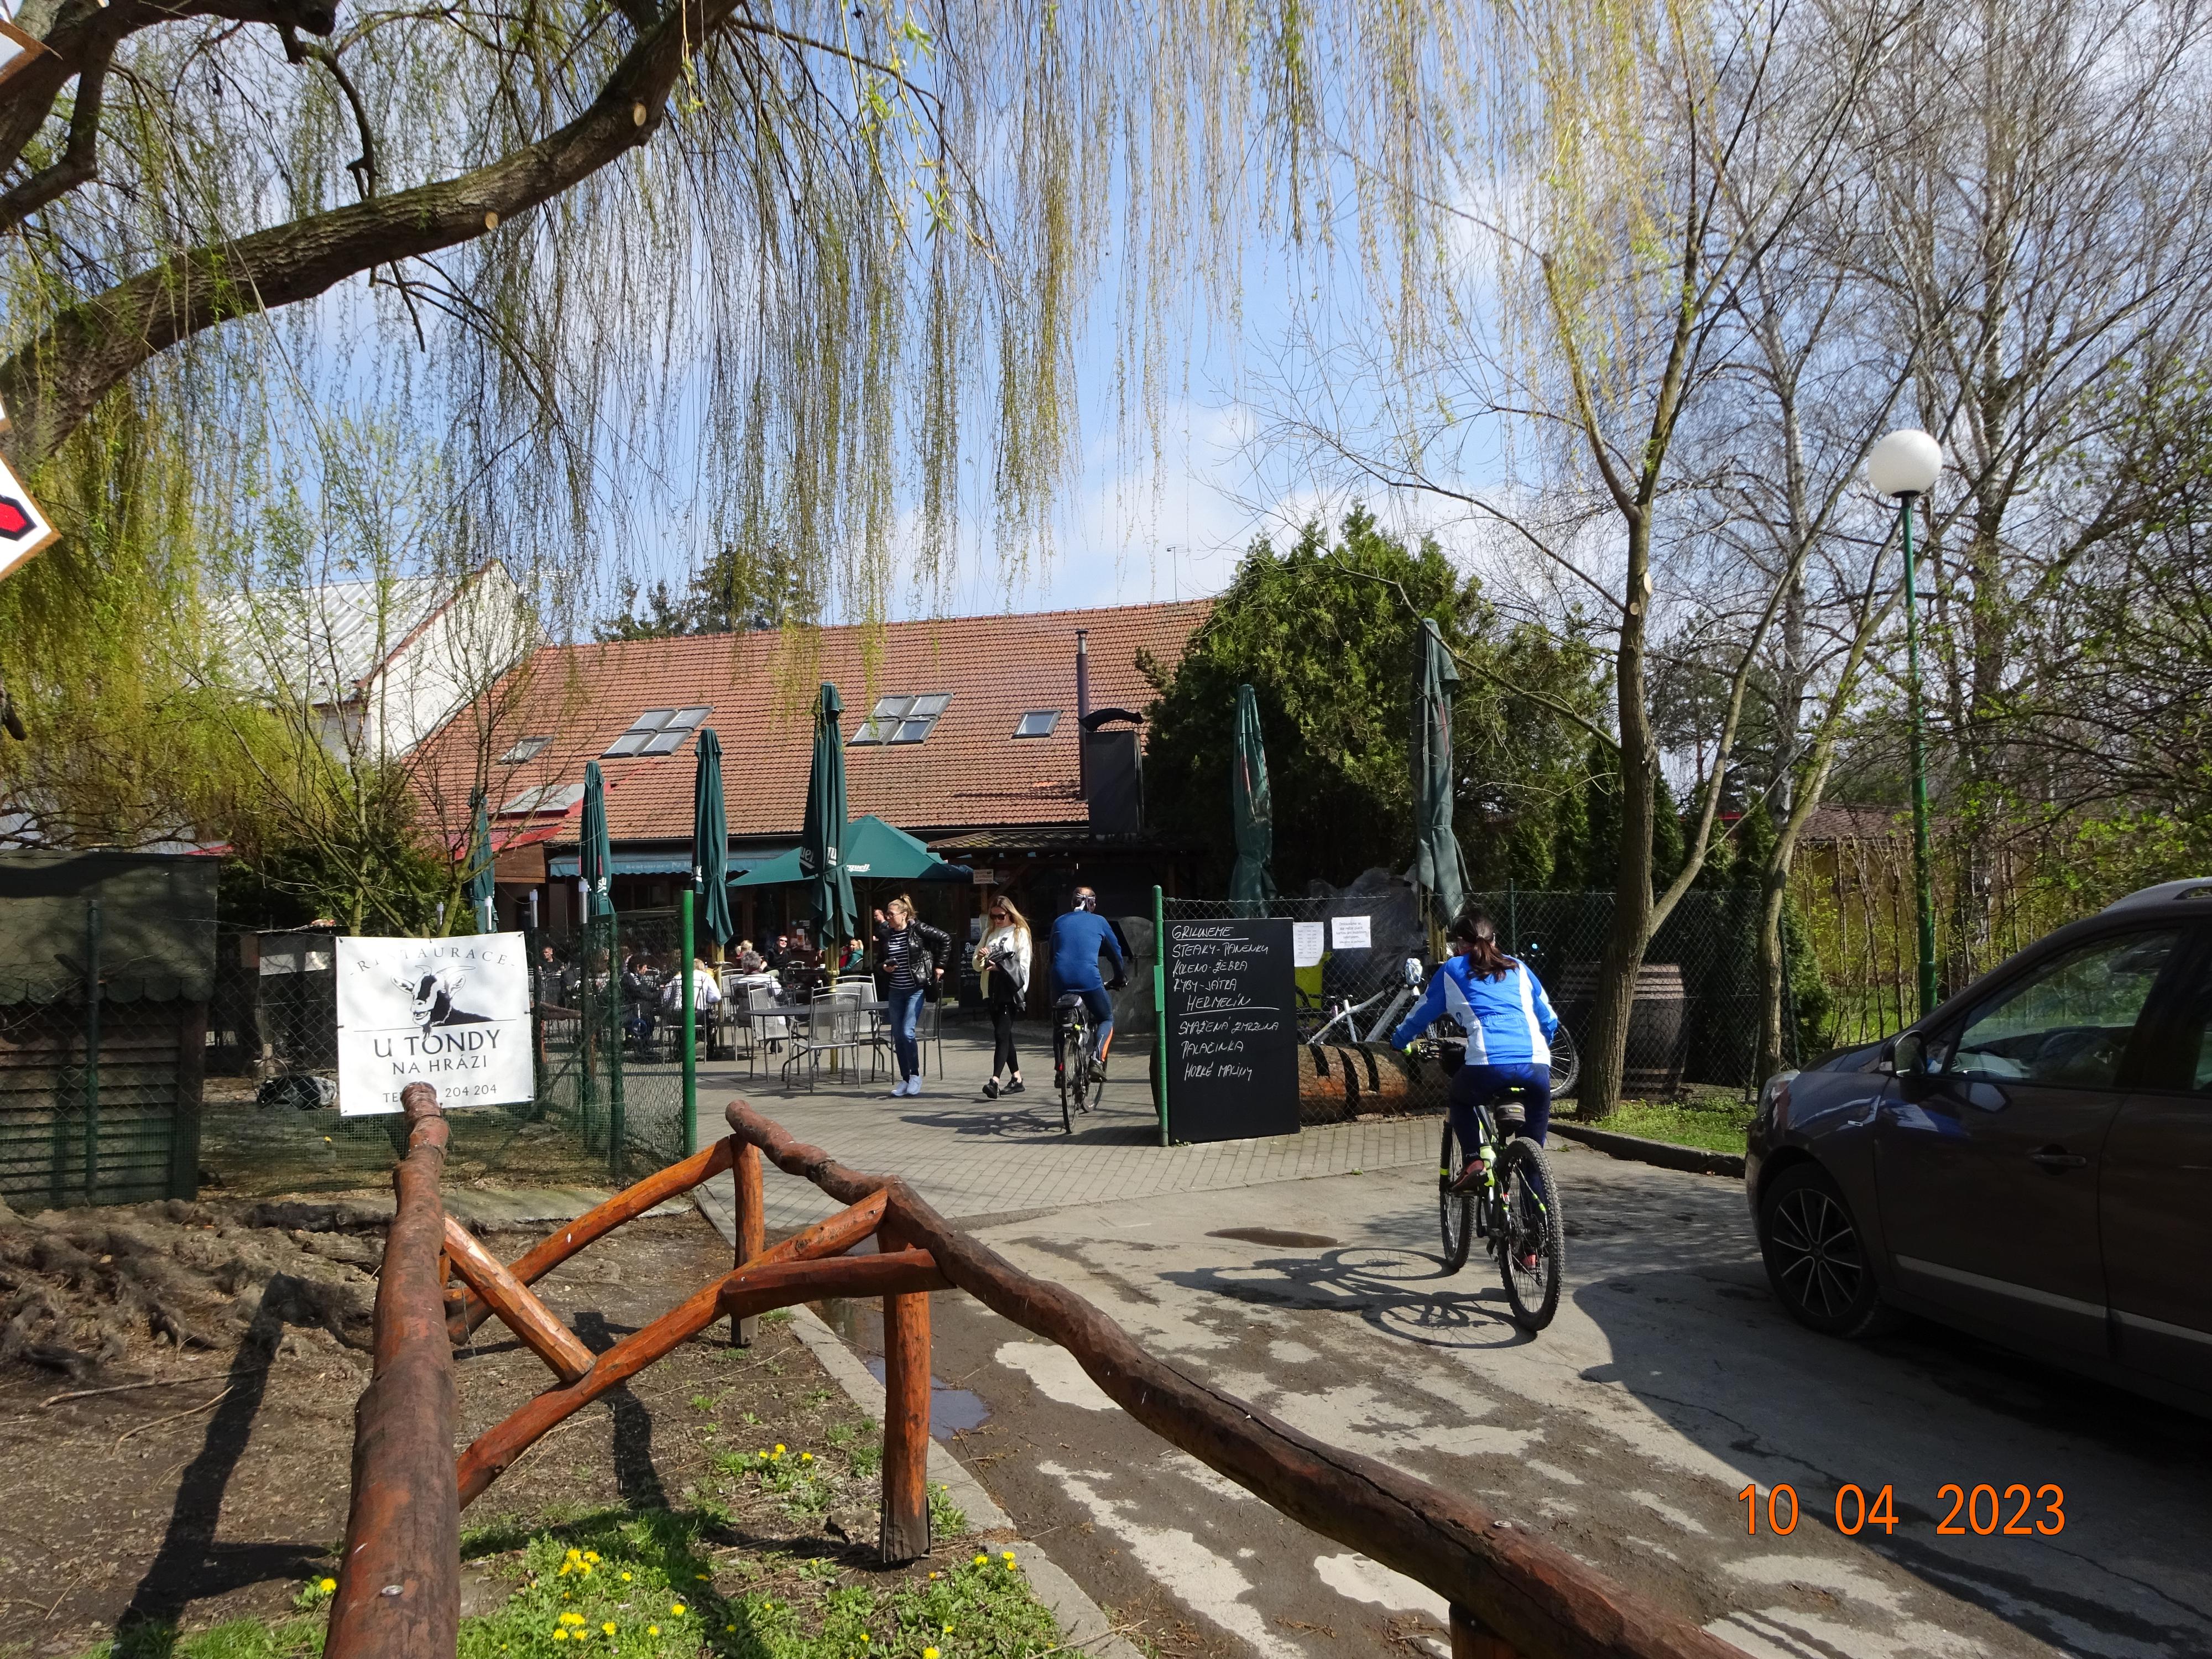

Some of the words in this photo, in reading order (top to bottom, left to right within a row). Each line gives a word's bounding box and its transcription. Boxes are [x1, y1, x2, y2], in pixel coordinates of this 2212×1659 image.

[357, 947, 508, 973] RTAURACE
[1187, 993, 1251, 1011] HERMELÍN
[373, 1038, 393, 1058] U
[404, 1029, 501, 1056] TONDY
[1181, 1040, 1244, 1060] PALAČINKA
[392, 1061, 420, 1075] NA
[429, 1054, 487, 1073] HRÁZI
[1184, 1061, 1214, 1081] HORKÉ
[1218, 1062, 1253, 1082] MALINY
[382, 1092, 401, 1103] TE
[445, 1086, 469, 1098] 204
[473, 1084, 497, 1095] 204
